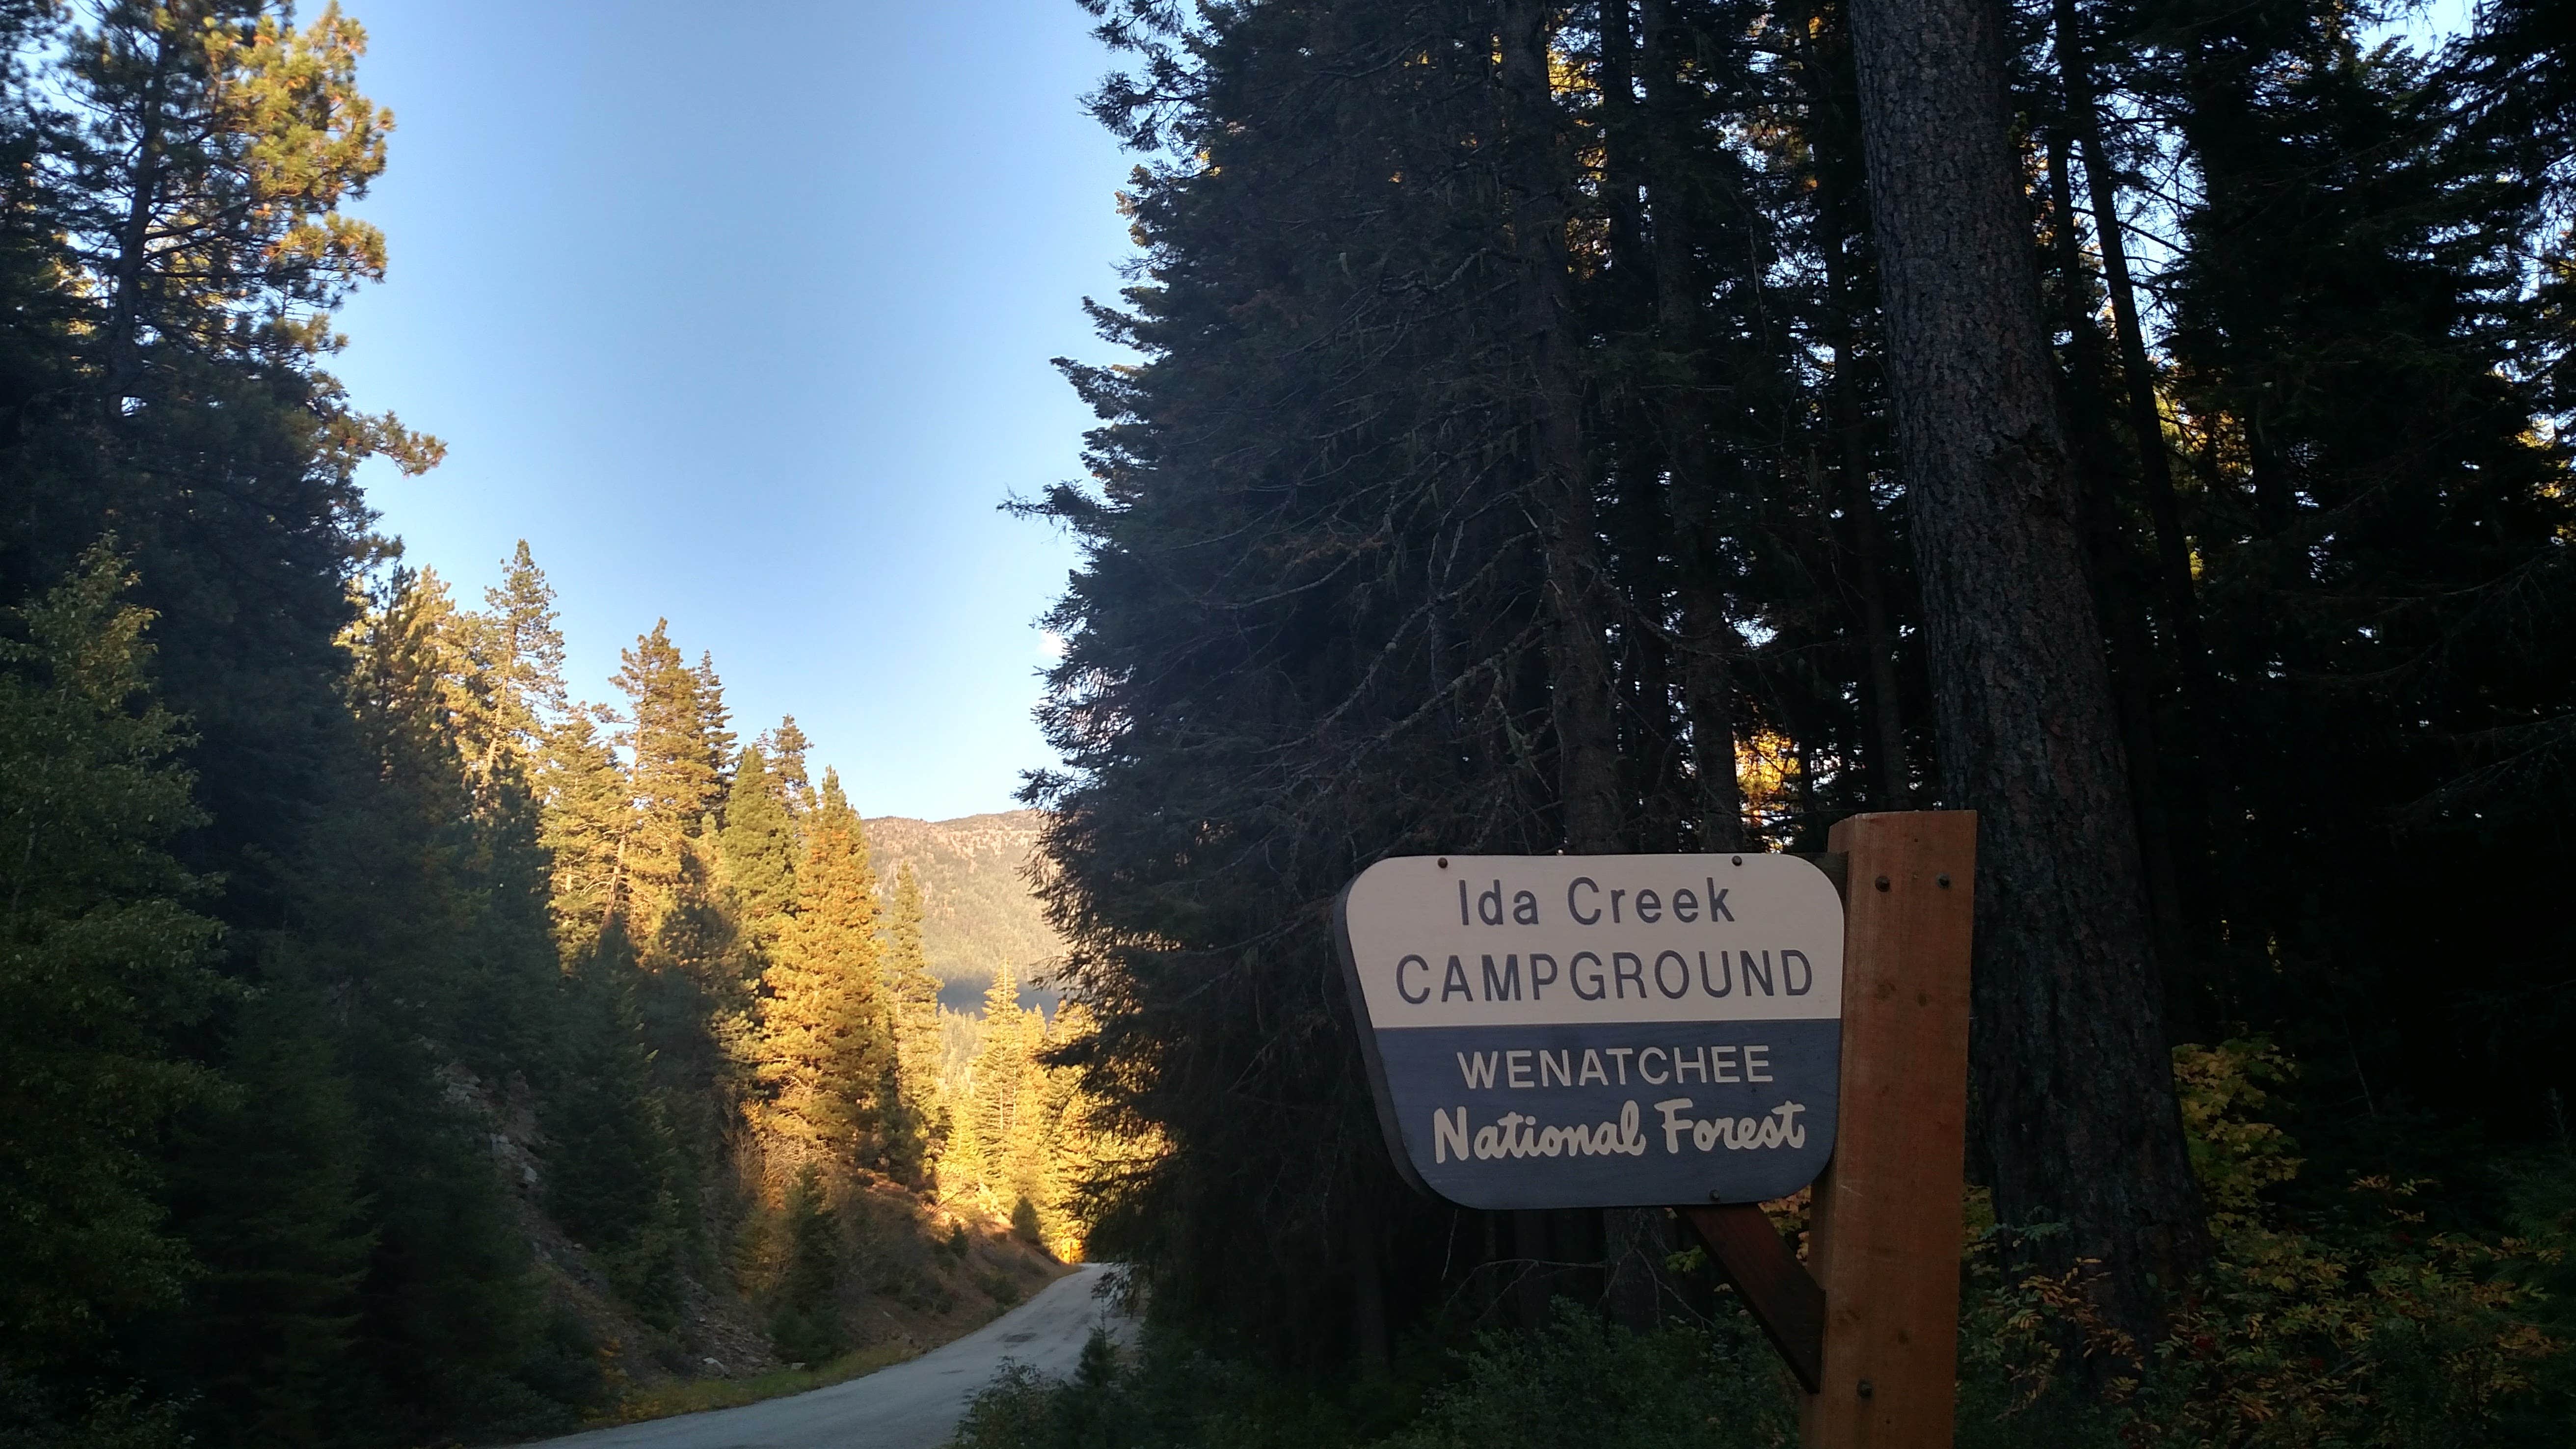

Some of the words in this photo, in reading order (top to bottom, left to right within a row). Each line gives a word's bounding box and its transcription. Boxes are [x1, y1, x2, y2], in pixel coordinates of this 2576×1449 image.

[1459, 879, 1540, 926] Ida
[1567, 876, 1736, 925] Creek
[1395, 948, 1813, 1005] CAMPGROUND
[1456, 1045, 1773, 1089] WENATCHEE
[1433, 1100, 1646, 1164] National
[1654, 1098, 1805, 1154] Forest
